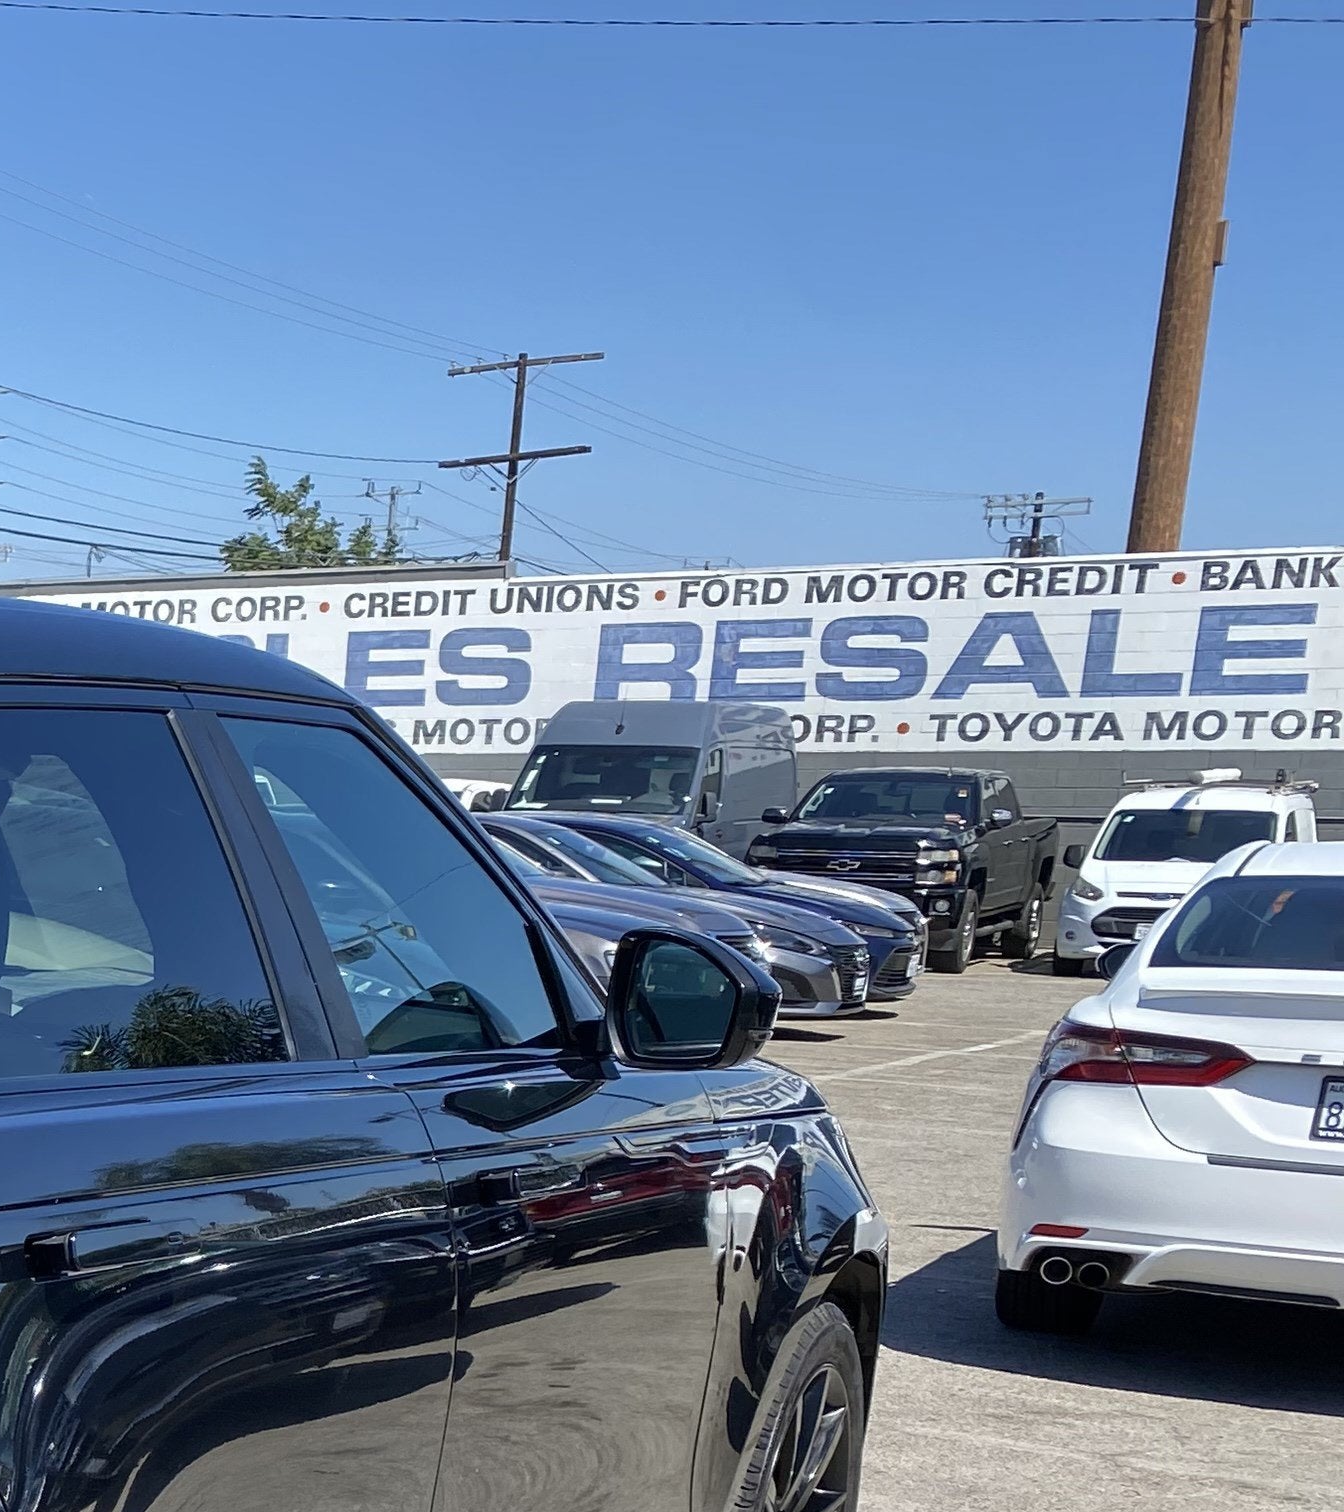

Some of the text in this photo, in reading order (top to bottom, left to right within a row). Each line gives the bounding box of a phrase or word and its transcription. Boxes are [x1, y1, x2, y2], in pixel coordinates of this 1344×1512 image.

[343, 582, 640, 619] CREDIT UNIONS
[677, 562, 1160, 609] FORD MOTOR CREDIT
[211, 595, 307, 624] CORP.
[593, 602, 1319, 703] RESALE
[791, 714, 879, 743] ORP.
[928, 709, 1343, 743] TOYOTA MOTOR
